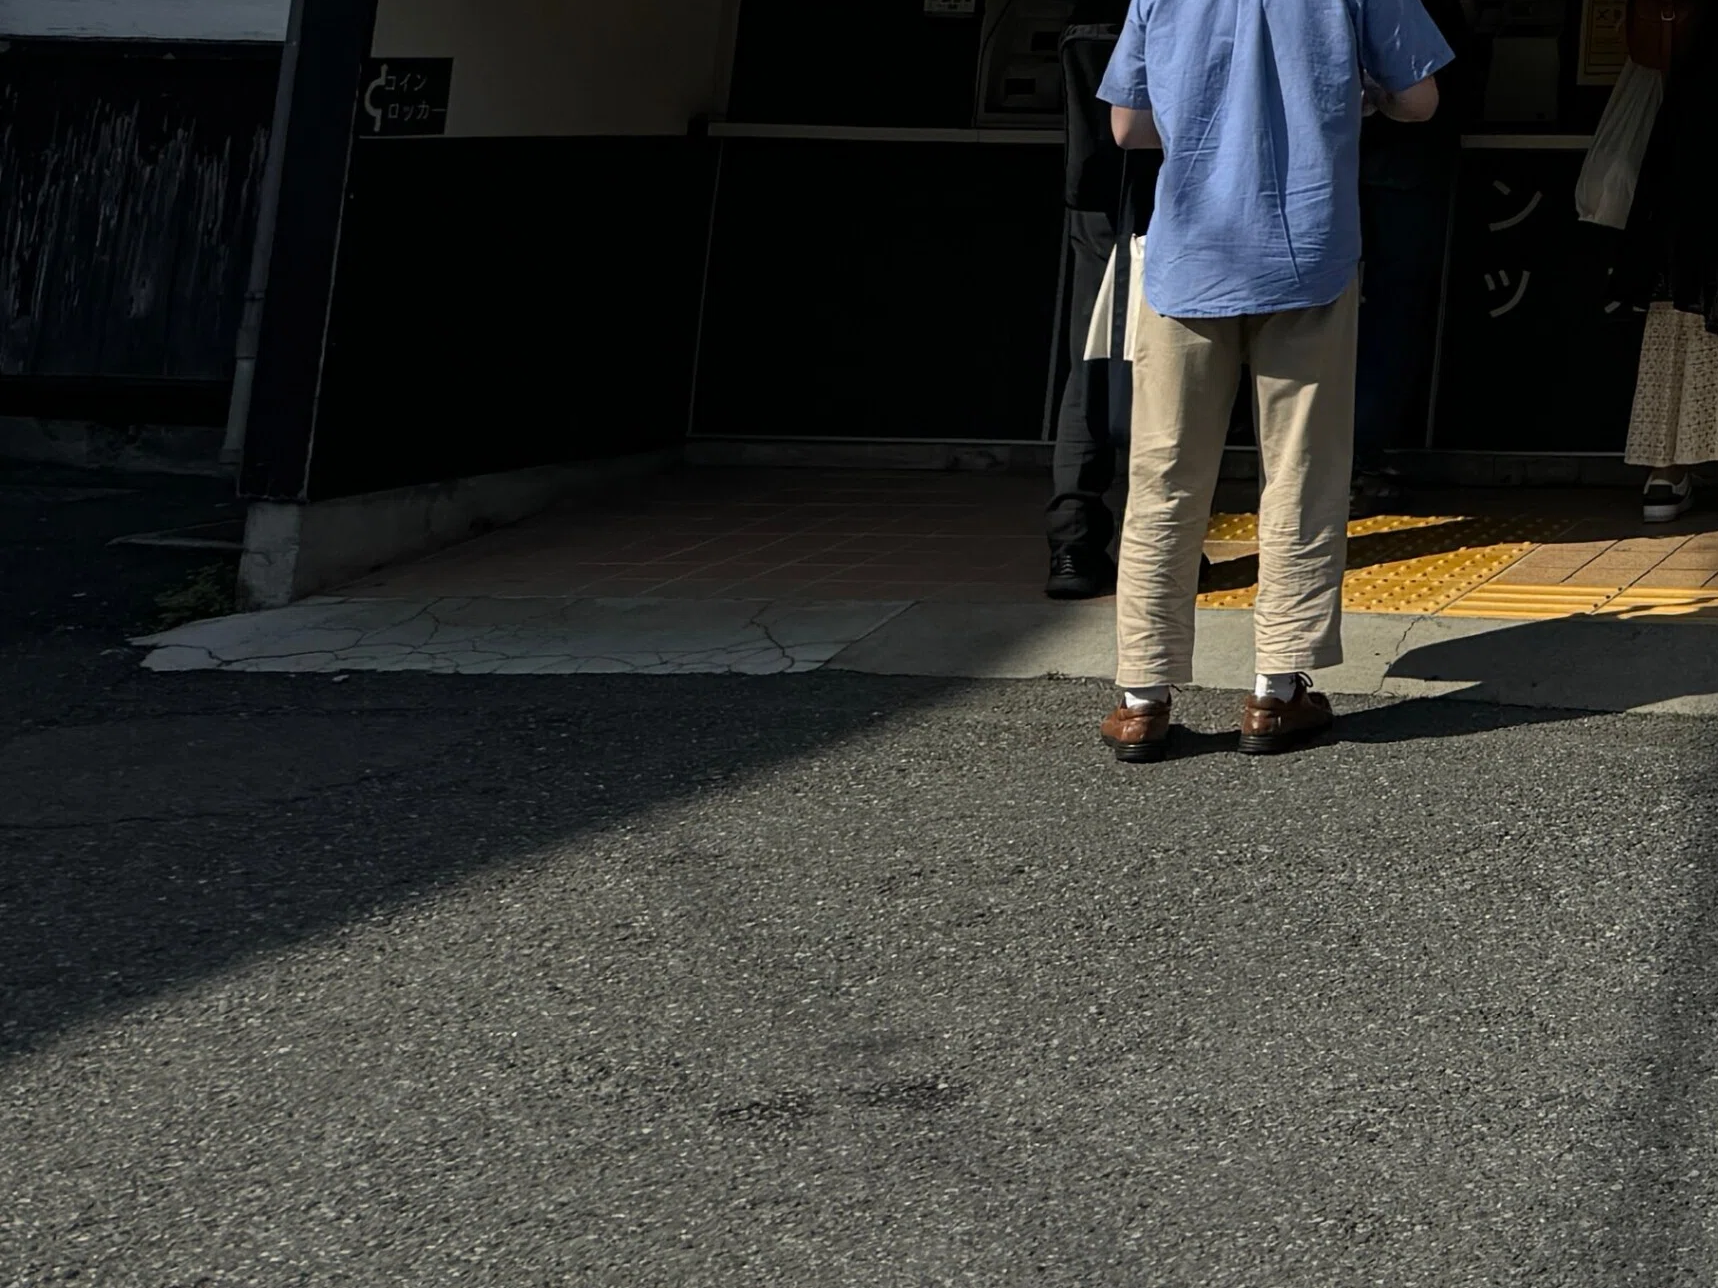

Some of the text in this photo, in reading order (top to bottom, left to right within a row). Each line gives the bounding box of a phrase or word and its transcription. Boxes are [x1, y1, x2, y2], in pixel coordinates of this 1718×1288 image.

[384, 71, 429, 94] コイン
[387, 98, 447, 122] ロッカー
